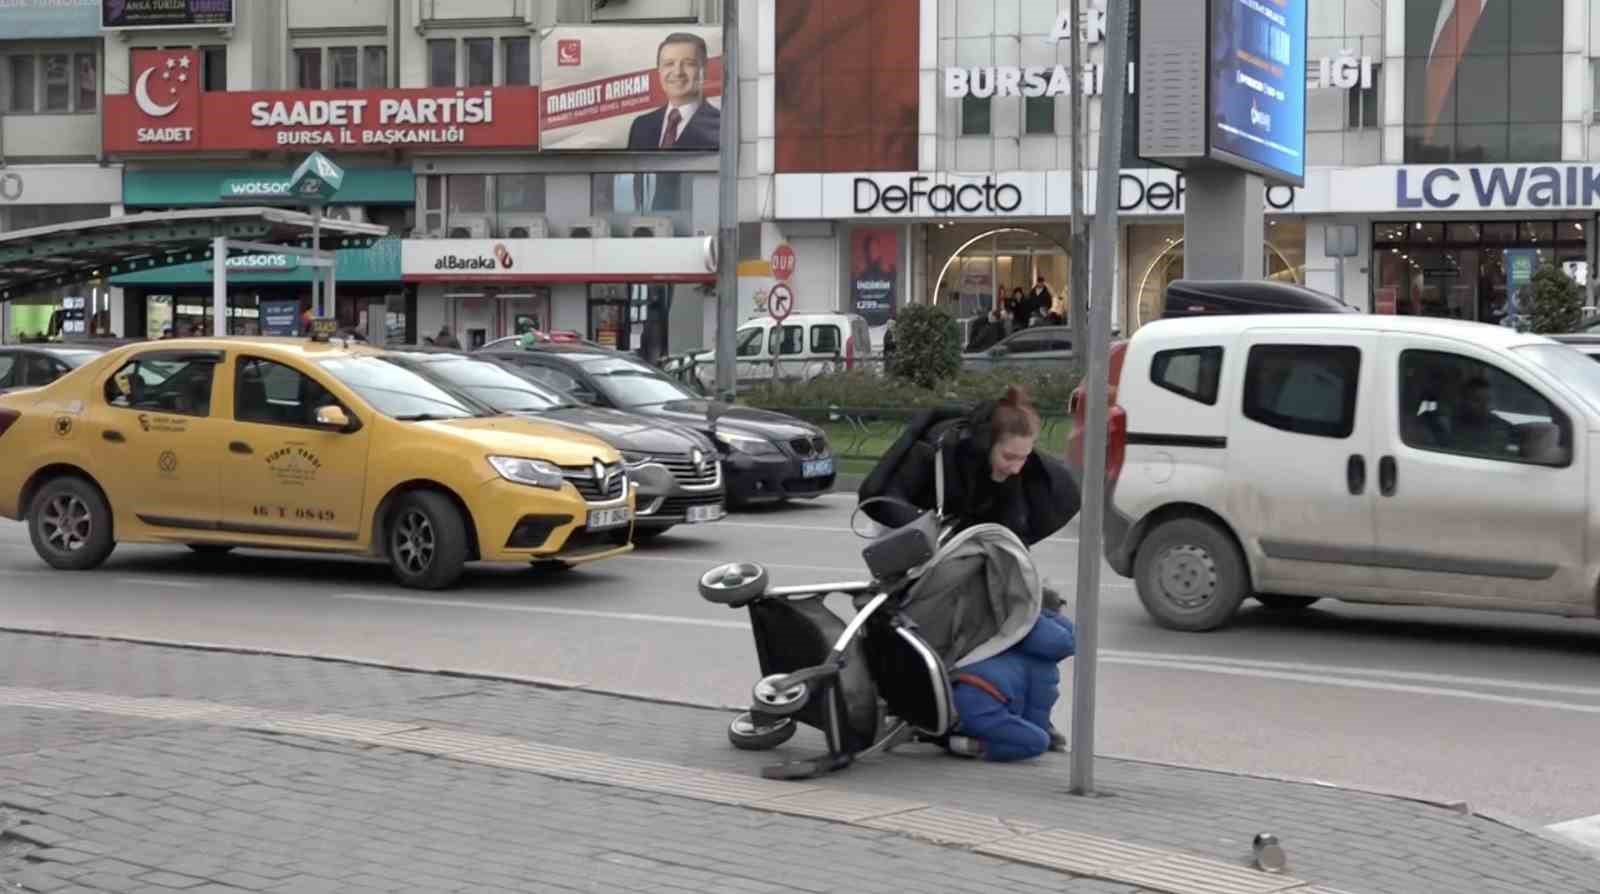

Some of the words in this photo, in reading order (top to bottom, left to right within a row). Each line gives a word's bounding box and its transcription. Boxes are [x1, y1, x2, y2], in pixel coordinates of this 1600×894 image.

[547, 84, 602, 115] MAHMUT
[605, 74, 650, 101] ARIKAN
[944, 65, 1073, 98] BURSA
[251, 100, 367, 127] SAADET
[379, 90, 492, 125] PARTİSİ
[137, 127, 193, 143] SAADET
[276, 131, 334, 145] BURSA
[340, 127, 356, 144] İL
[362, 125, 465, 147] BAŞKANLIĞI
[231, 181, 291, 194] watson
[853, 176, 1022, 214] DeFacto
[1396, 167, 1461, 208] LC
[434, 255, 496, 270] alBaraka
[772, 253, 795, 271] DUR
